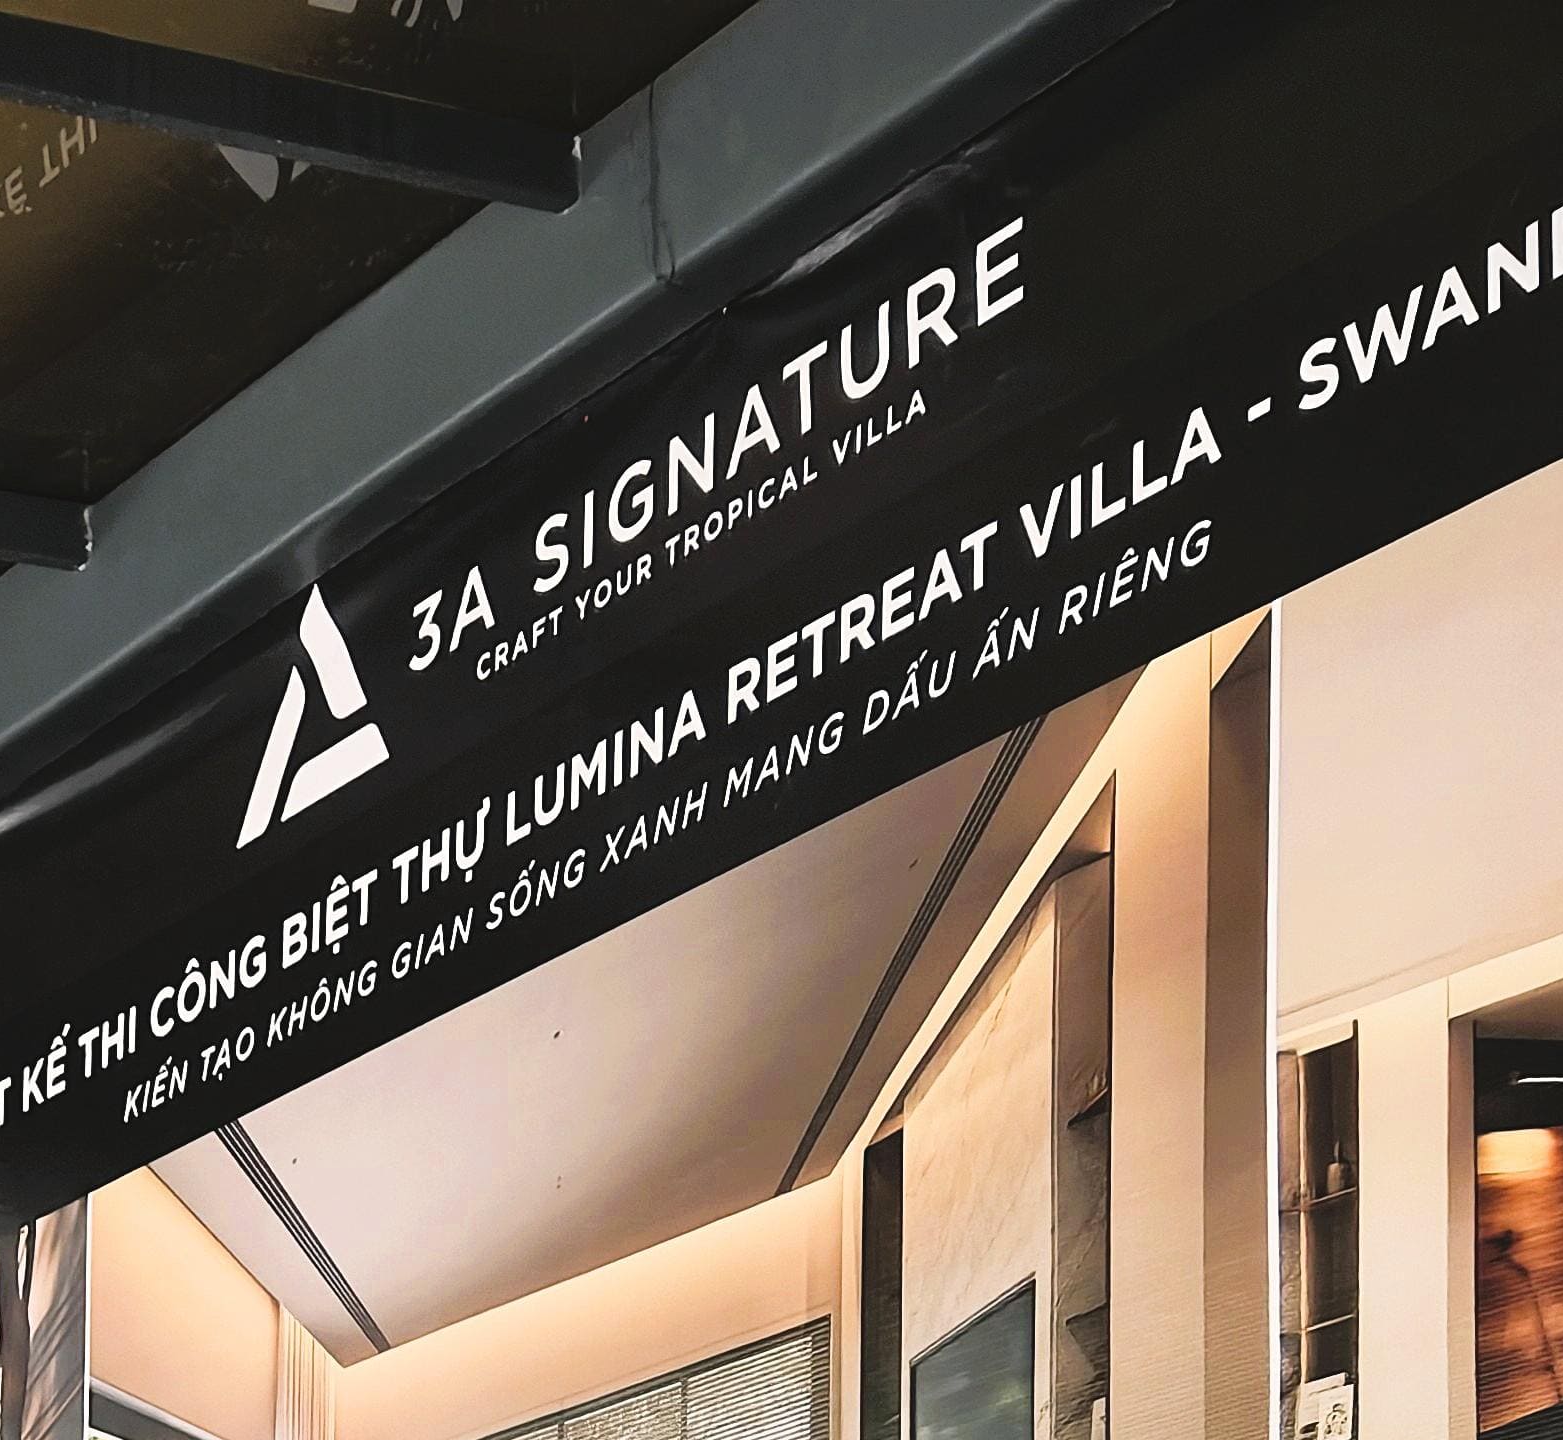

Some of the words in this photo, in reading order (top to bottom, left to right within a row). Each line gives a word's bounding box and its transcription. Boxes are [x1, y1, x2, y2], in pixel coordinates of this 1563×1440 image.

[408, 564, 496, 671] 3A
[533, 215, 1025, 593] SIGNATURE
[476, 605, 564, 682] CRAFT
[574, 553, 653, 622] YOUR
[664, 455, 819, 568] TROPICAL
[831, 388, 927, 466] VILLA
[21, 1022, 71, 1114] KẾ
[77, 1005, 137, 1080] THI
[149, 934, 267, 1039] CÔNG
[281, 868, 378, 971] BIỆT
[391, 796, 492, 906] THỰ
[505, 688, 708, 848] LUMINA
[726, 520, 999, 726] RETREAT
[1018, 405, 1223, 560] VILLA
[1247, 396, 1272, 423] -
[123, 1053, 189, 1124] KIẾN
[199, 1026, 256, 1084] TẠO
[266, 958, 379, 1049] KHÔNG
[390, 907, 474, 980] GIAN
[485, 855, 587, 932] SỐNG
[598, 796, 709, 874] XANH
[722, 710, 846, 809] MANG
[862, 645, 958, 736] DẤU
[970, 606, 1040, 681] ẤN
[1057, 518, 1213, 636] RIÊNG
